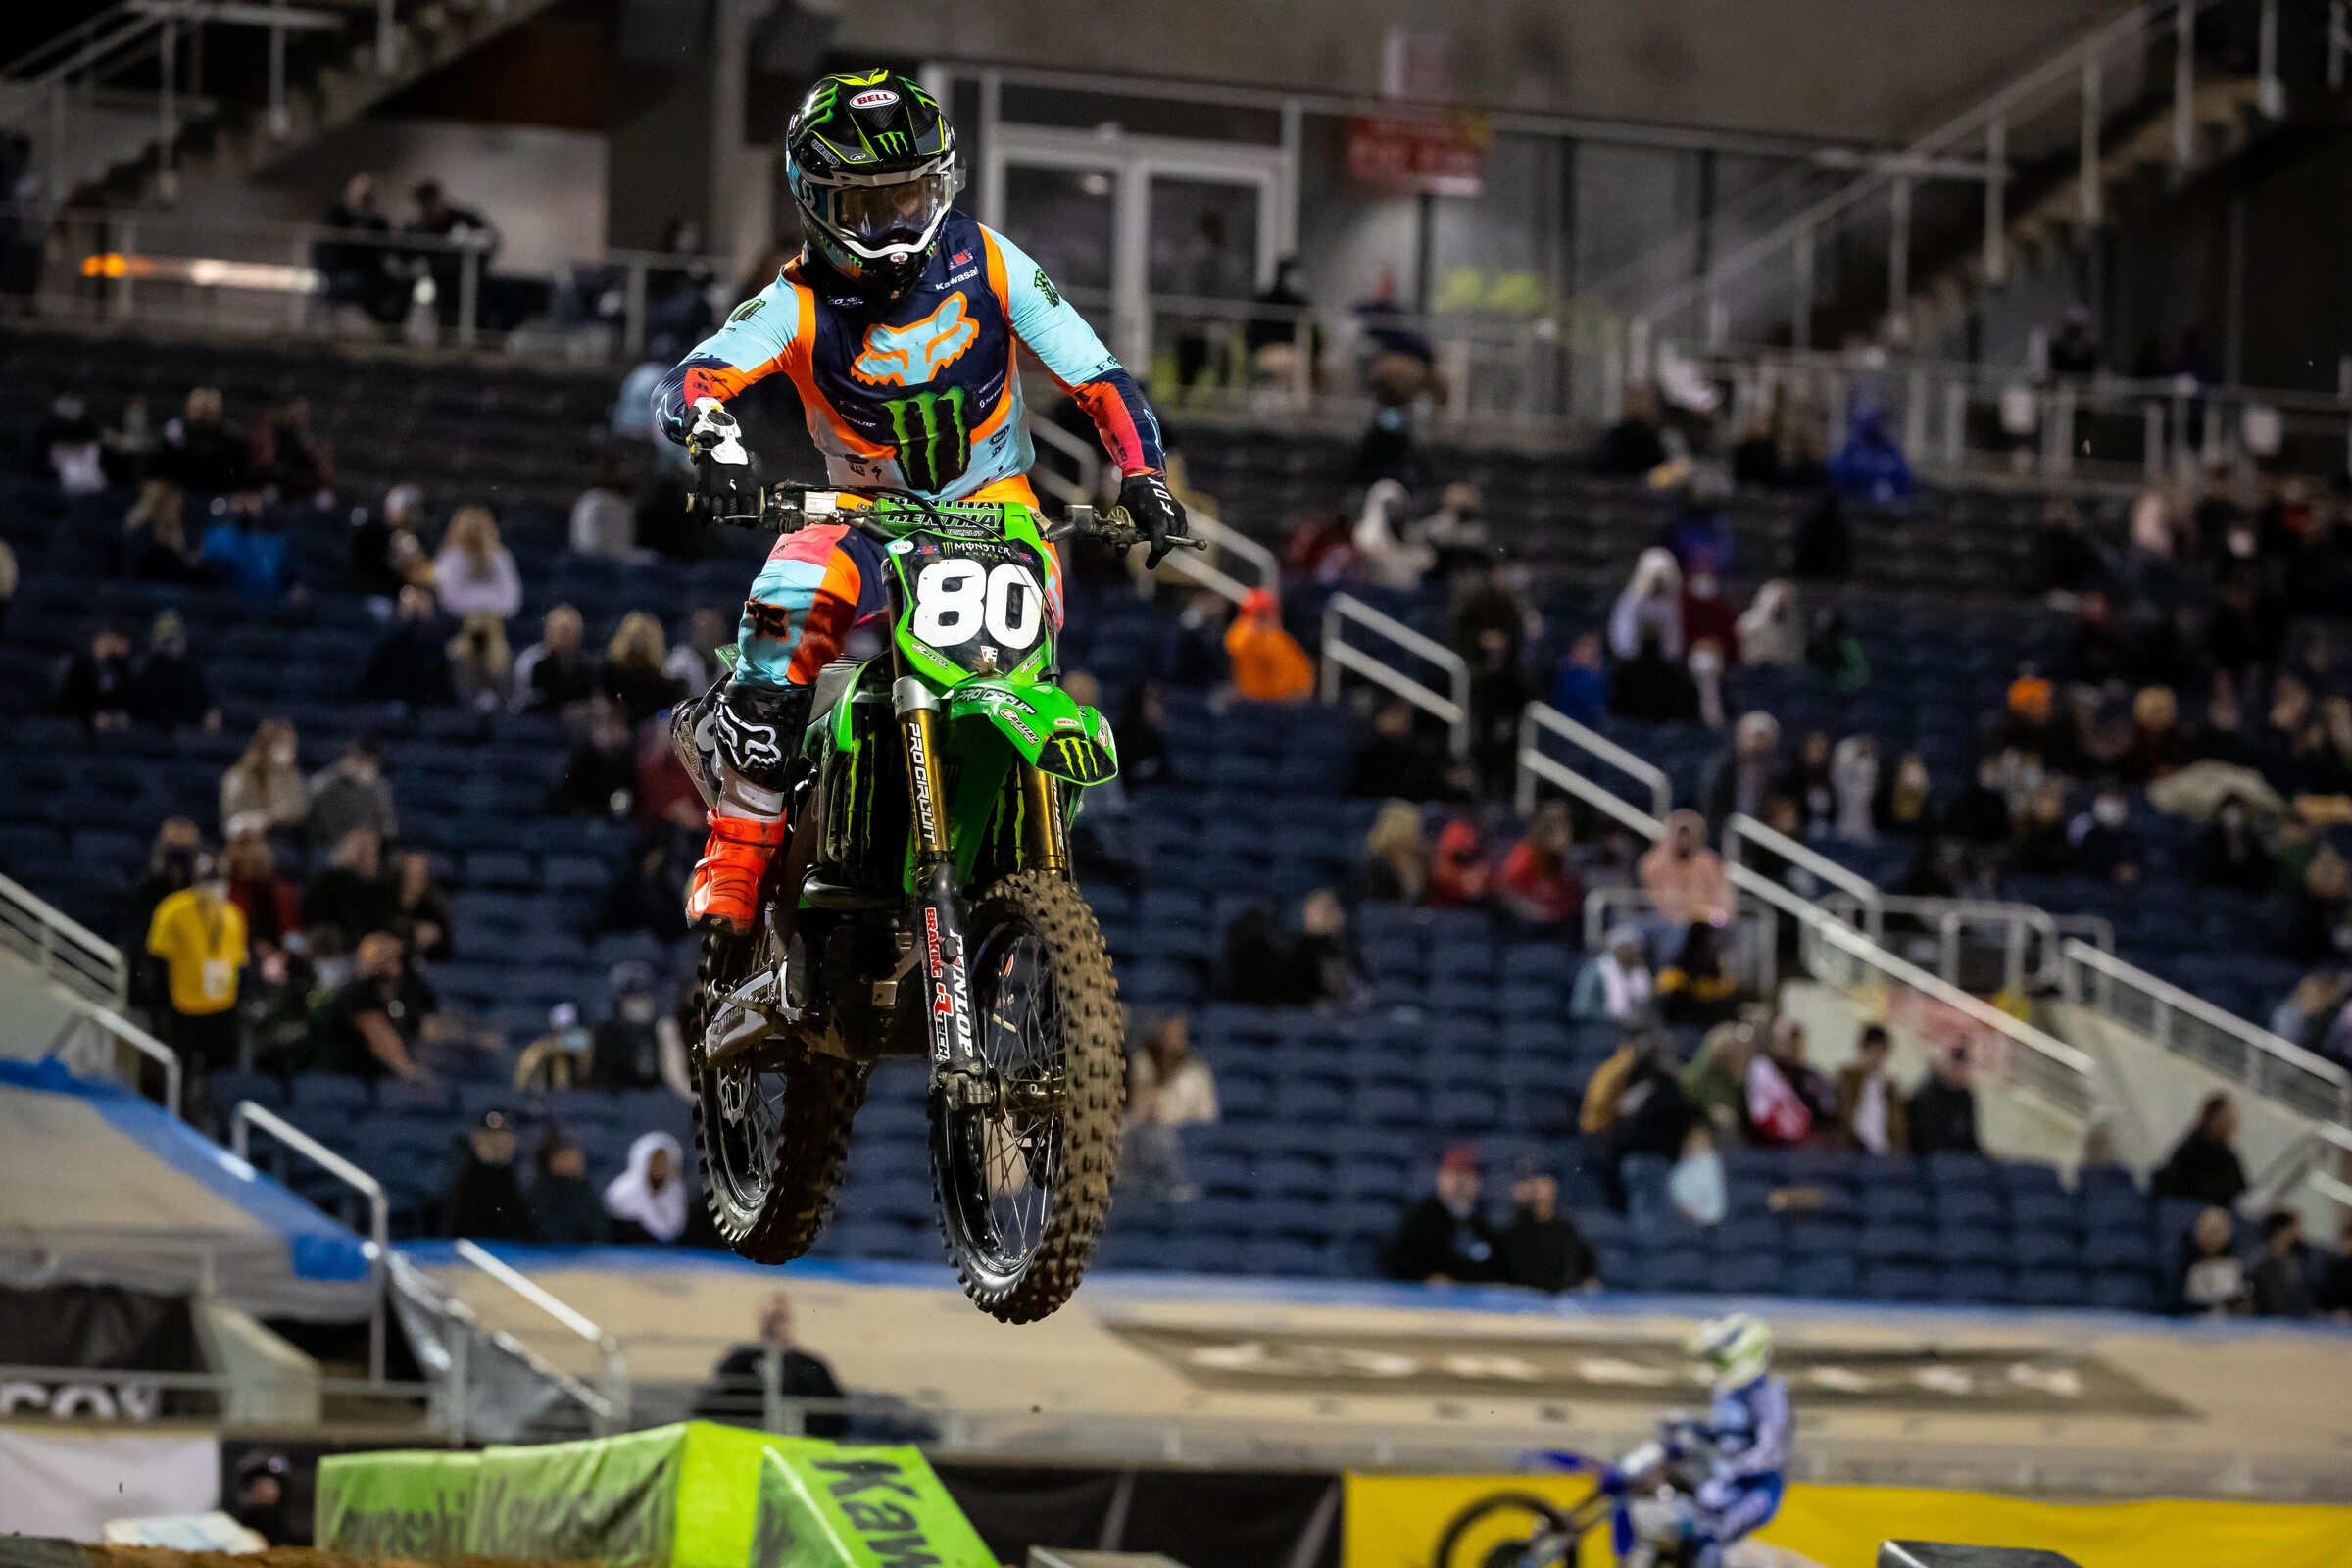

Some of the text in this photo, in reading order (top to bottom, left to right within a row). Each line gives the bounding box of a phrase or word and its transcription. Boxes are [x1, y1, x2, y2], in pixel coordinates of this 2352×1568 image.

[857, 93, 892, 106] BELL
[1147, 476, 1175, 516] FOX
[955, 542, 1012, 557] MONSTER
[965, 551, 1005, 561] ENERGY
[913, 558, 1045, 650] 80
[954, 687, 1037, 715] PRO CIRCUIT
[908, 722, 937, 844] PRO CIRCUIT
[925, 907, 943, 978] BRAKING
